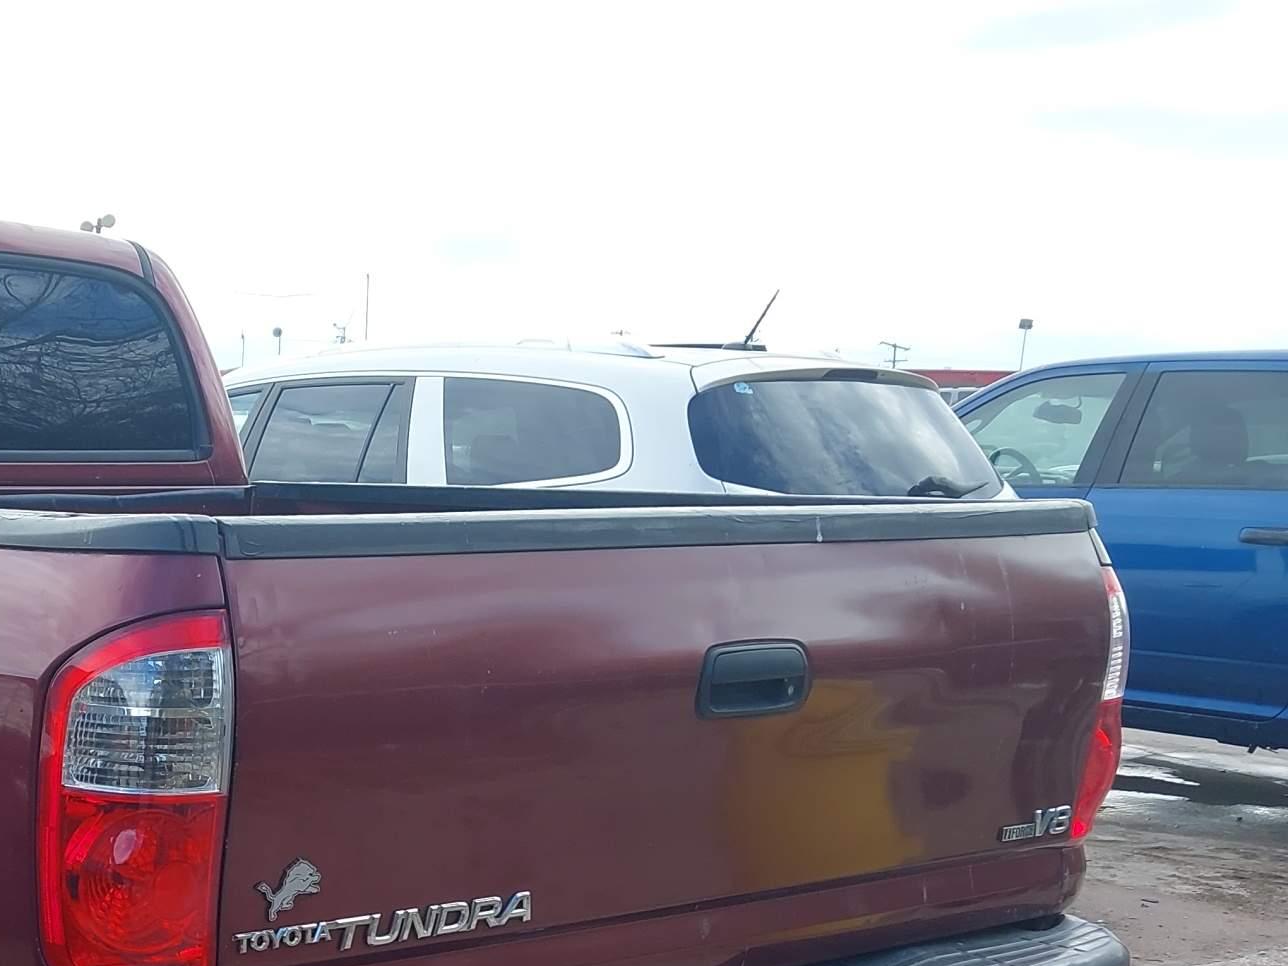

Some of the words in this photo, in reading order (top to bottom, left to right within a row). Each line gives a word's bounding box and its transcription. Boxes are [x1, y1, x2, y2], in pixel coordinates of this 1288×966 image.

[1034, 805, 1071, 837] V8
[233, 922, 331, 953] TOYOTA
[328, 891, 531, 950] TUNDRA
